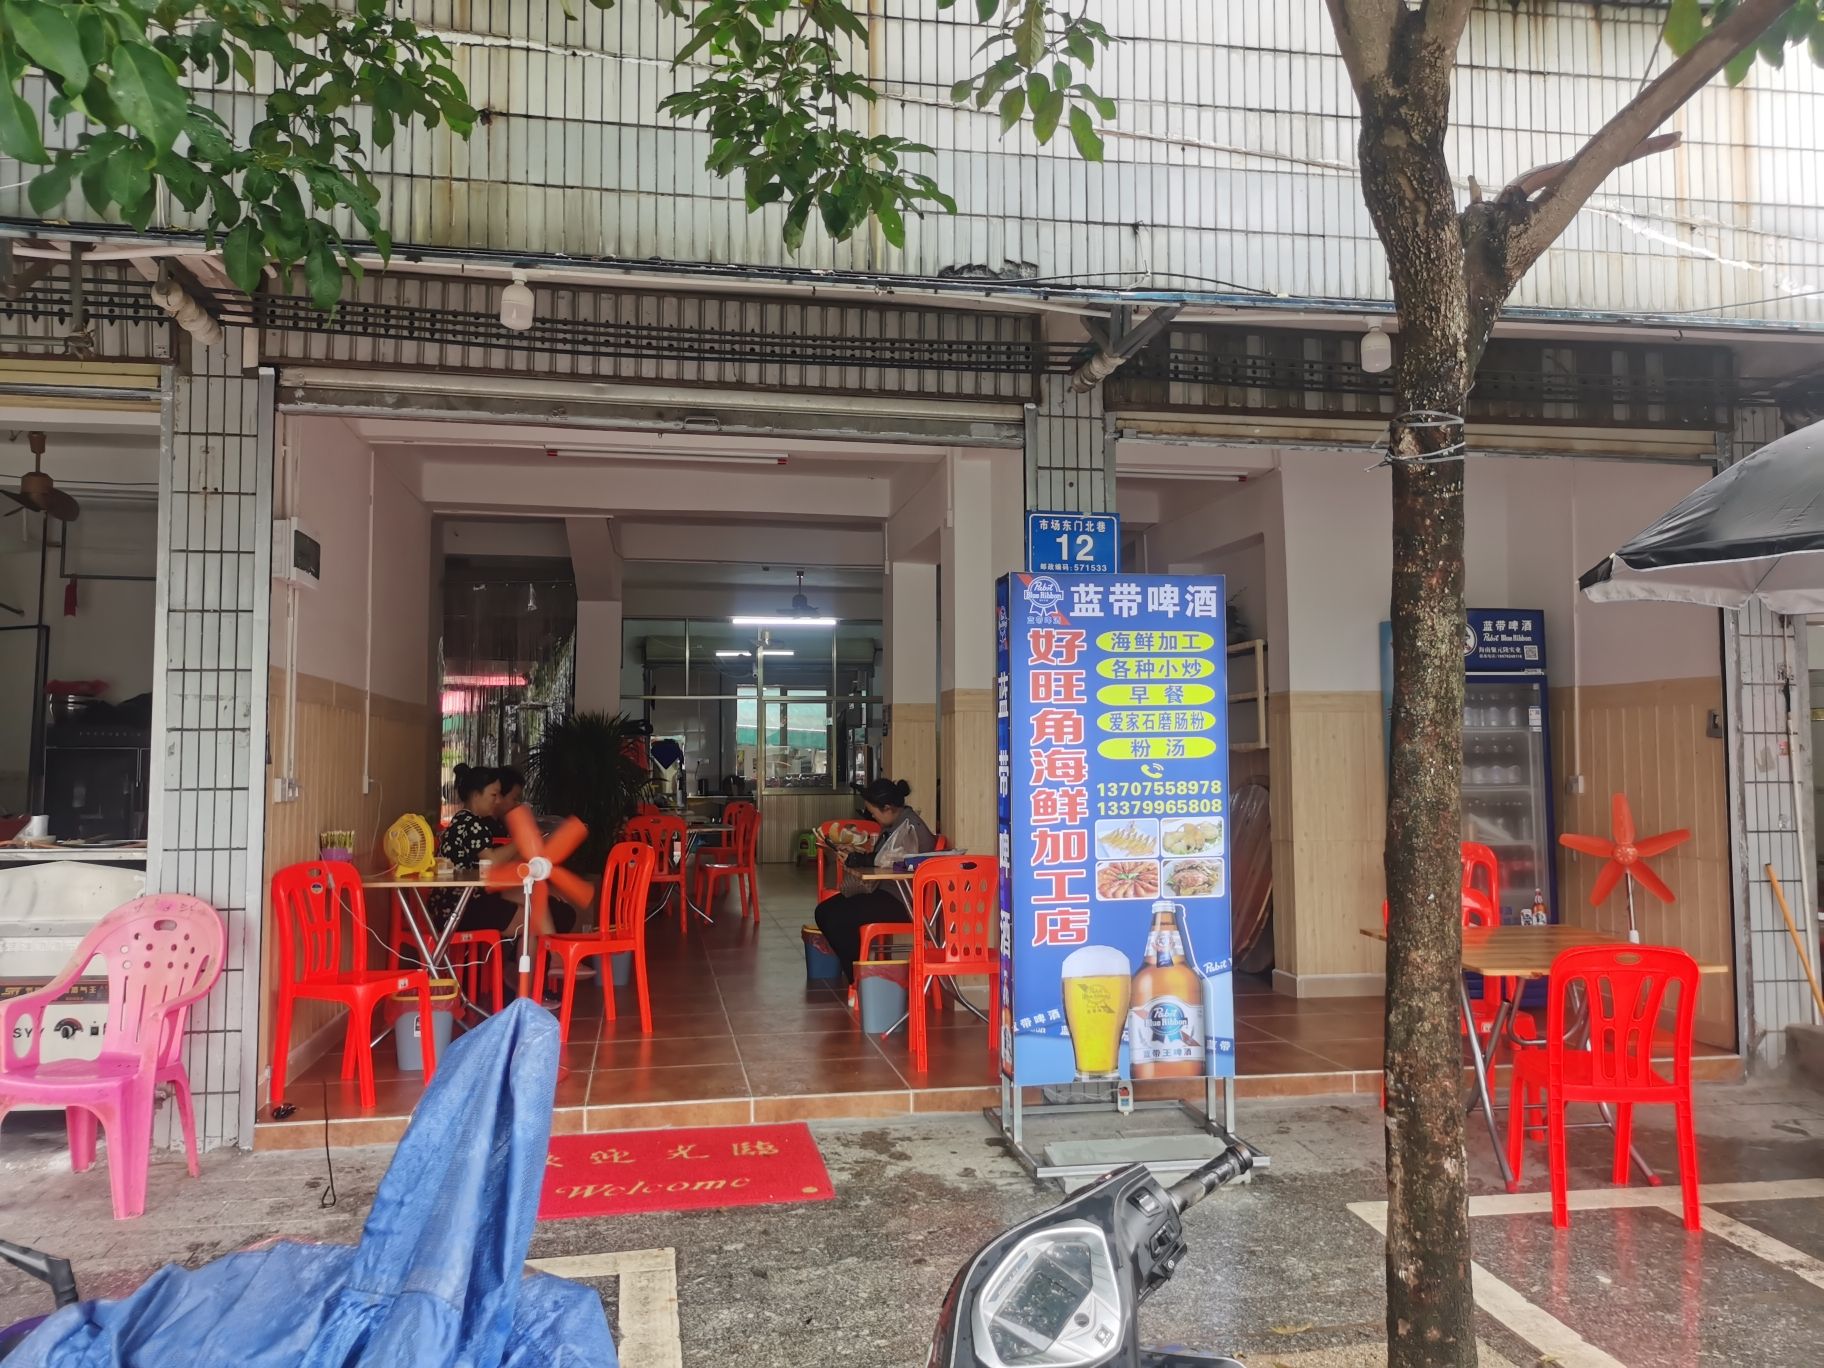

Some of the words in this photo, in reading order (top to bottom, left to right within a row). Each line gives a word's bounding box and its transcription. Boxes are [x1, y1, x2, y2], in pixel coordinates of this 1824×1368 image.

[1039, 519, 1106, 532] 市场东门北巷
[1055, 533, 1094, 561] 12
[1069, 582, 1217, 618] 蓝带啤酒
[1482, 619, 1532, 632] 蓝带啤酒
[1111, 632, 1202, 651] 海鲜加工
[1111, 659, 1202, 679] 各种小炒
[1129, 685, 1185, 704] 早餐
[1109, 712, 1205, 732] 爱家石磨肠粉
[1130, 739, 1186, 758] 粉汤
[1026, 627, 1090, 947] 好旺角海鲜加工店
[1096, 780, 1222, 797] 13707558978
[1096, 798, 1222, 816] 13379965808
[555, 1176, 750, 1199] Welcome
